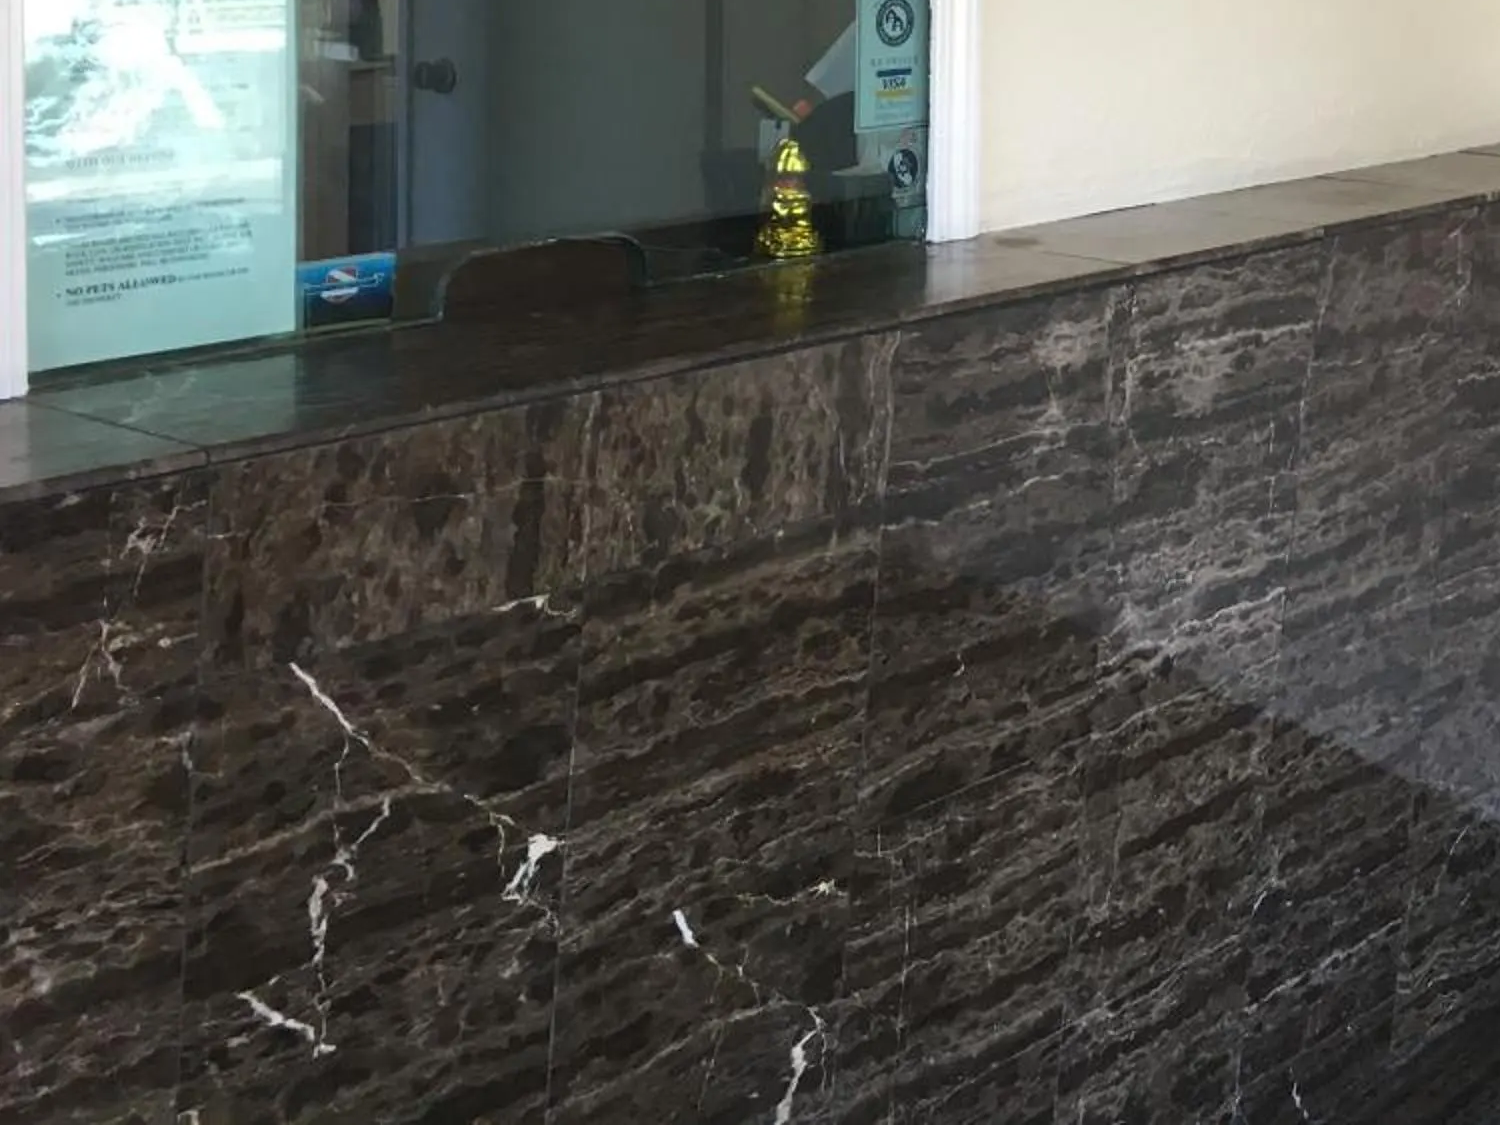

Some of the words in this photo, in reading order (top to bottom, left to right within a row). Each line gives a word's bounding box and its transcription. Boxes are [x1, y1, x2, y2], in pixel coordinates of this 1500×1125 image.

[881, 76, 907, 90] VISA
[65, 287, 83, 297] NO
[86, 282, 115, 295] PETS
[117, 274, 177, 292] ALLOWED
